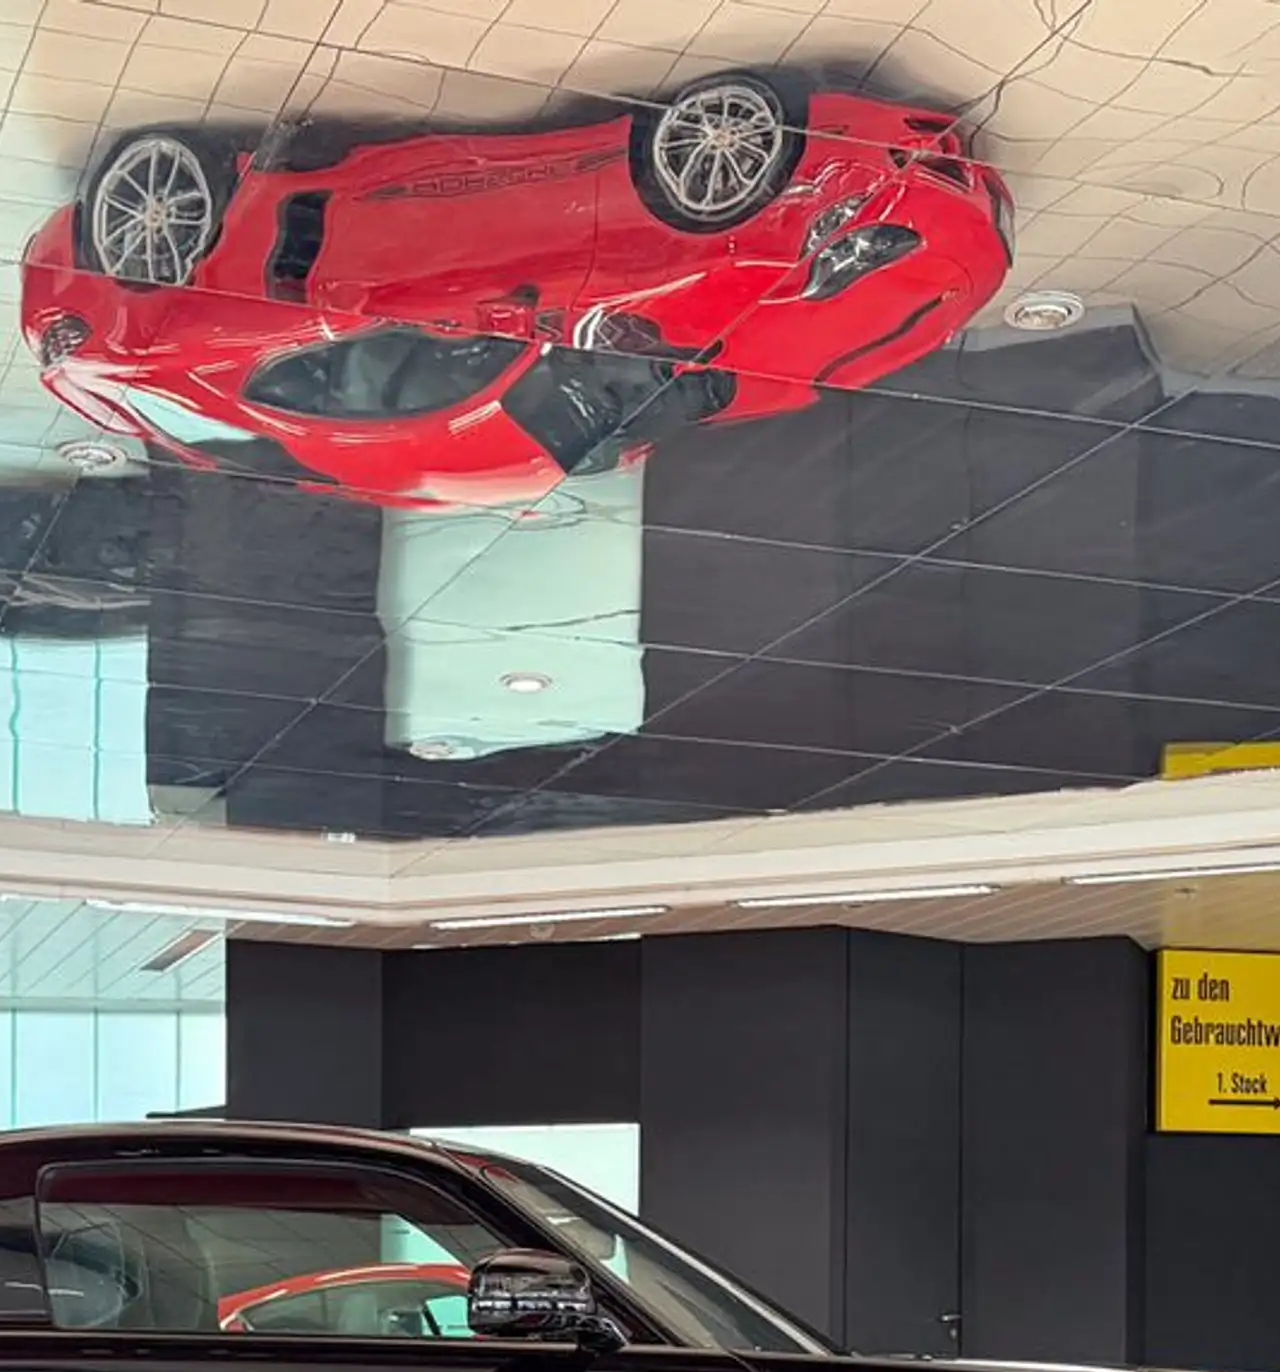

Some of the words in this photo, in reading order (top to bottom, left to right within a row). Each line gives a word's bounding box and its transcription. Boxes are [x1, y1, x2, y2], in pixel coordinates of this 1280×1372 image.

[1172, 977, 1190, 1000] zu
[1197, 972, 1230, 1002] den
[1217, 1072, 1228, 1093] 1.
[1231, 1073, 1268, 1095] Stock
